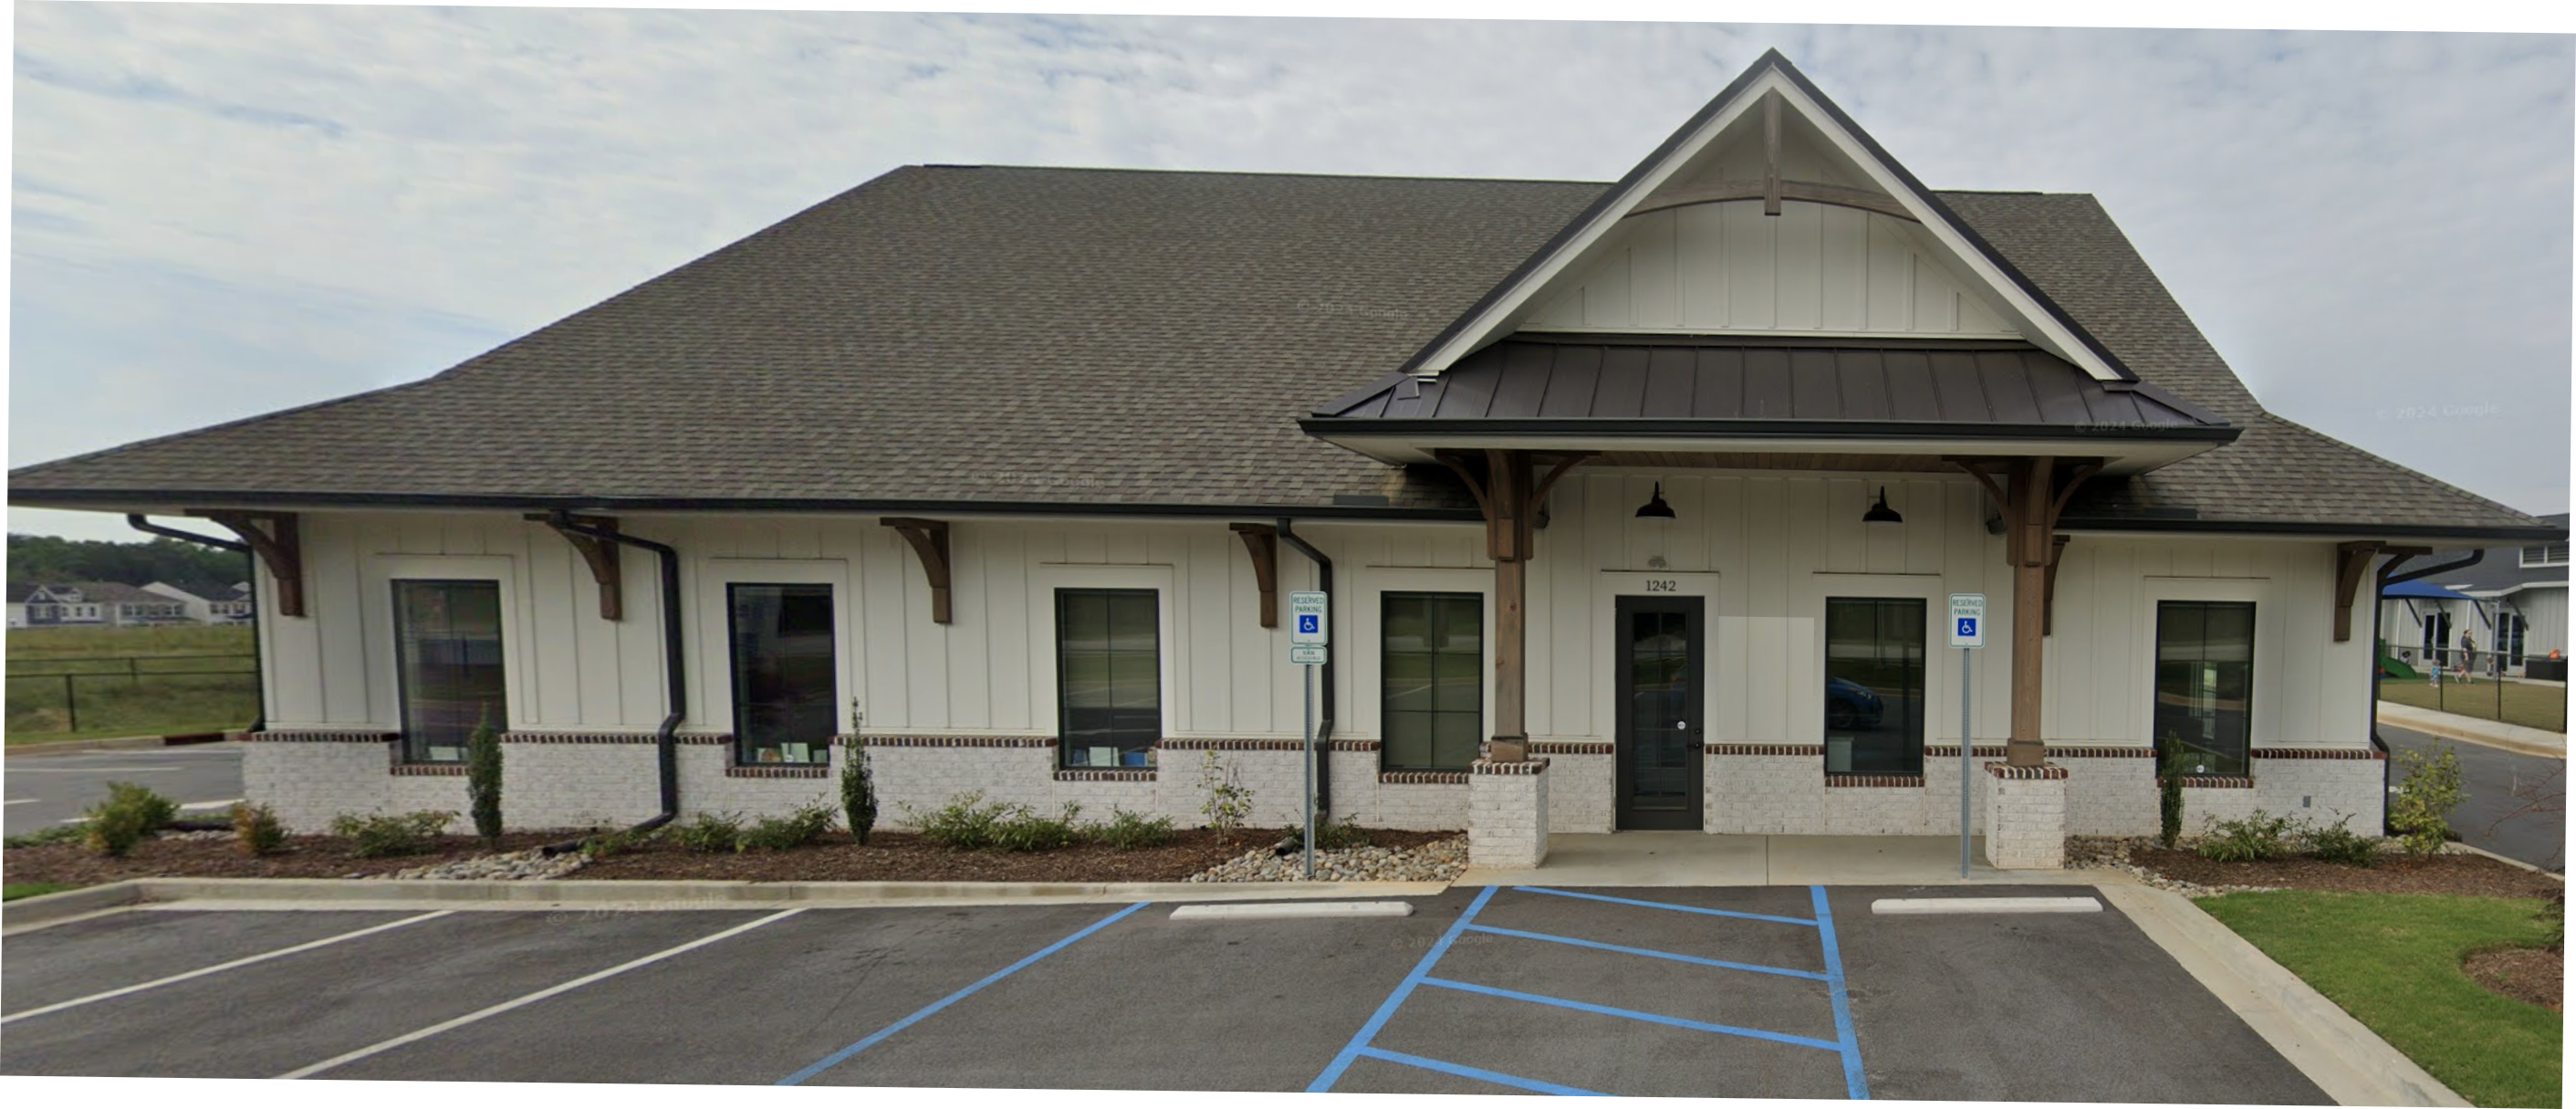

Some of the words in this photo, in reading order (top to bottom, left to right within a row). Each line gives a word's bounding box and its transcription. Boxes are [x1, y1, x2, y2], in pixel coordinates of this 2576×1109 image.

[1645, 580, 1677, 591] 1242
[1293, 596, 1324, 604] RESERVED
[1953, 599, 1983, 607] RESERVED
[1295, 605, 1322, 613] PARKING
[1954, 608, 1980, 616] PARKING
